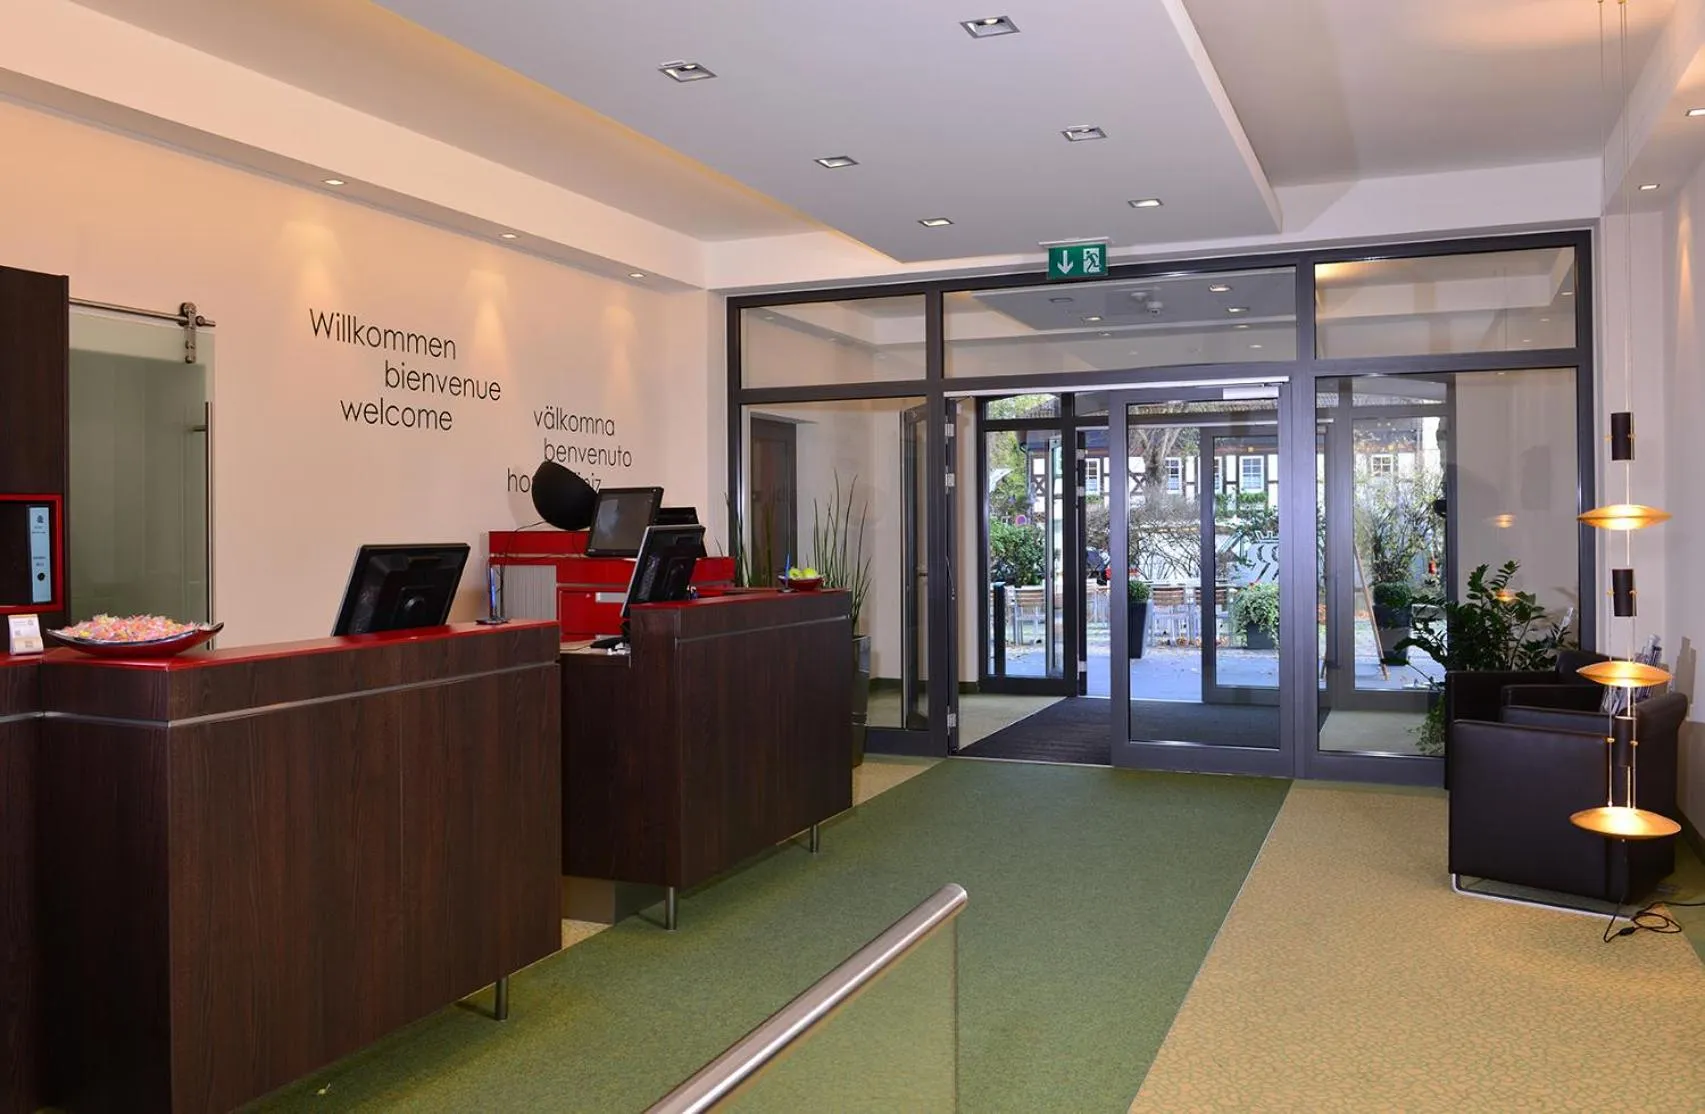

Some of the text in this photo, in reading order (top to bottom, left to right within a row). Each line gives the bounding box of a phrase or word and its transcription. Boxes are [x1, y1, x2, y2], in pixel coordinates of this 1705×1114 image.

[309, 307, 456, 361] Willkommen
[384, 359, 502, 402] bienvenue
[340, 396, 453, 432] welcome
[533, 405, 616, 437] välkomna
[543, 437, 633, 468] benvenuto
